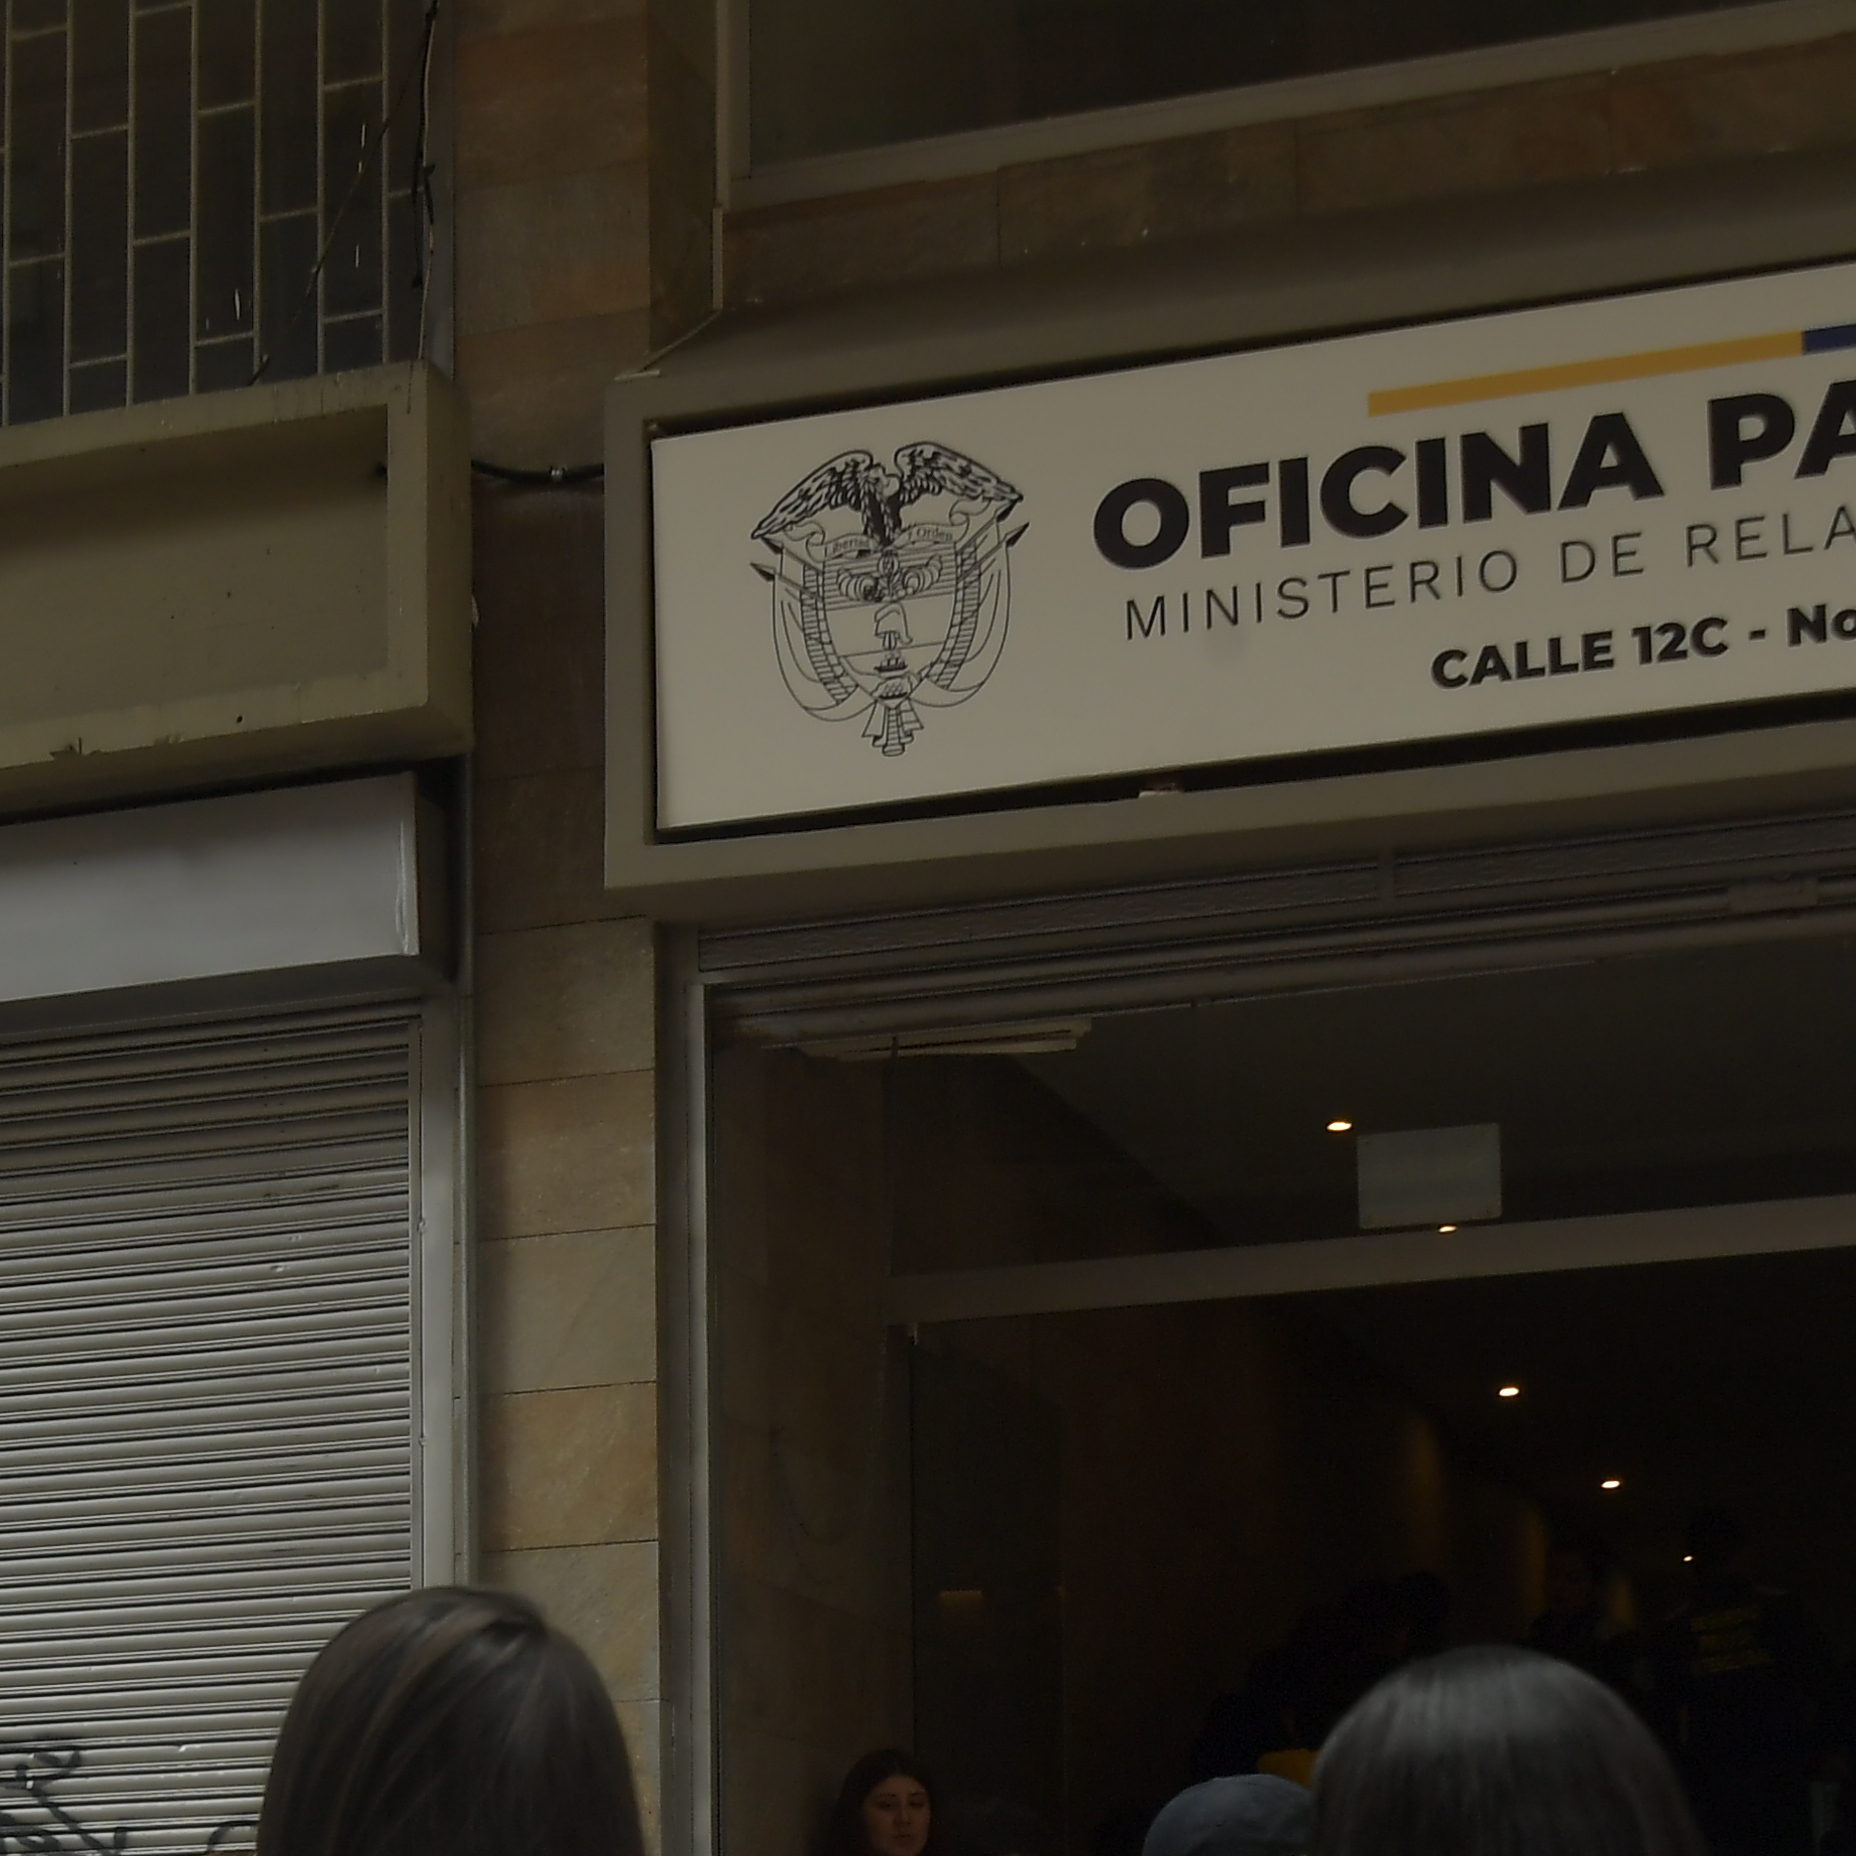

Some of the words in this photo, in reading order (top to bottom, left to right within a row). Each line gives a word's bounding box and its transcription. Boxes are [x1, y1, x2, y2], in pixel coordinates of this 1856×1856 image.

[1092, 411, 1666, 571] OFICINA
[1125, 549, 1518, 641] MINISTERIO
[1559, 531, 1645, 584] DE
[1430, 629, 1616, 690] CALLE
[1630, 615, 1730, 666] 12C
